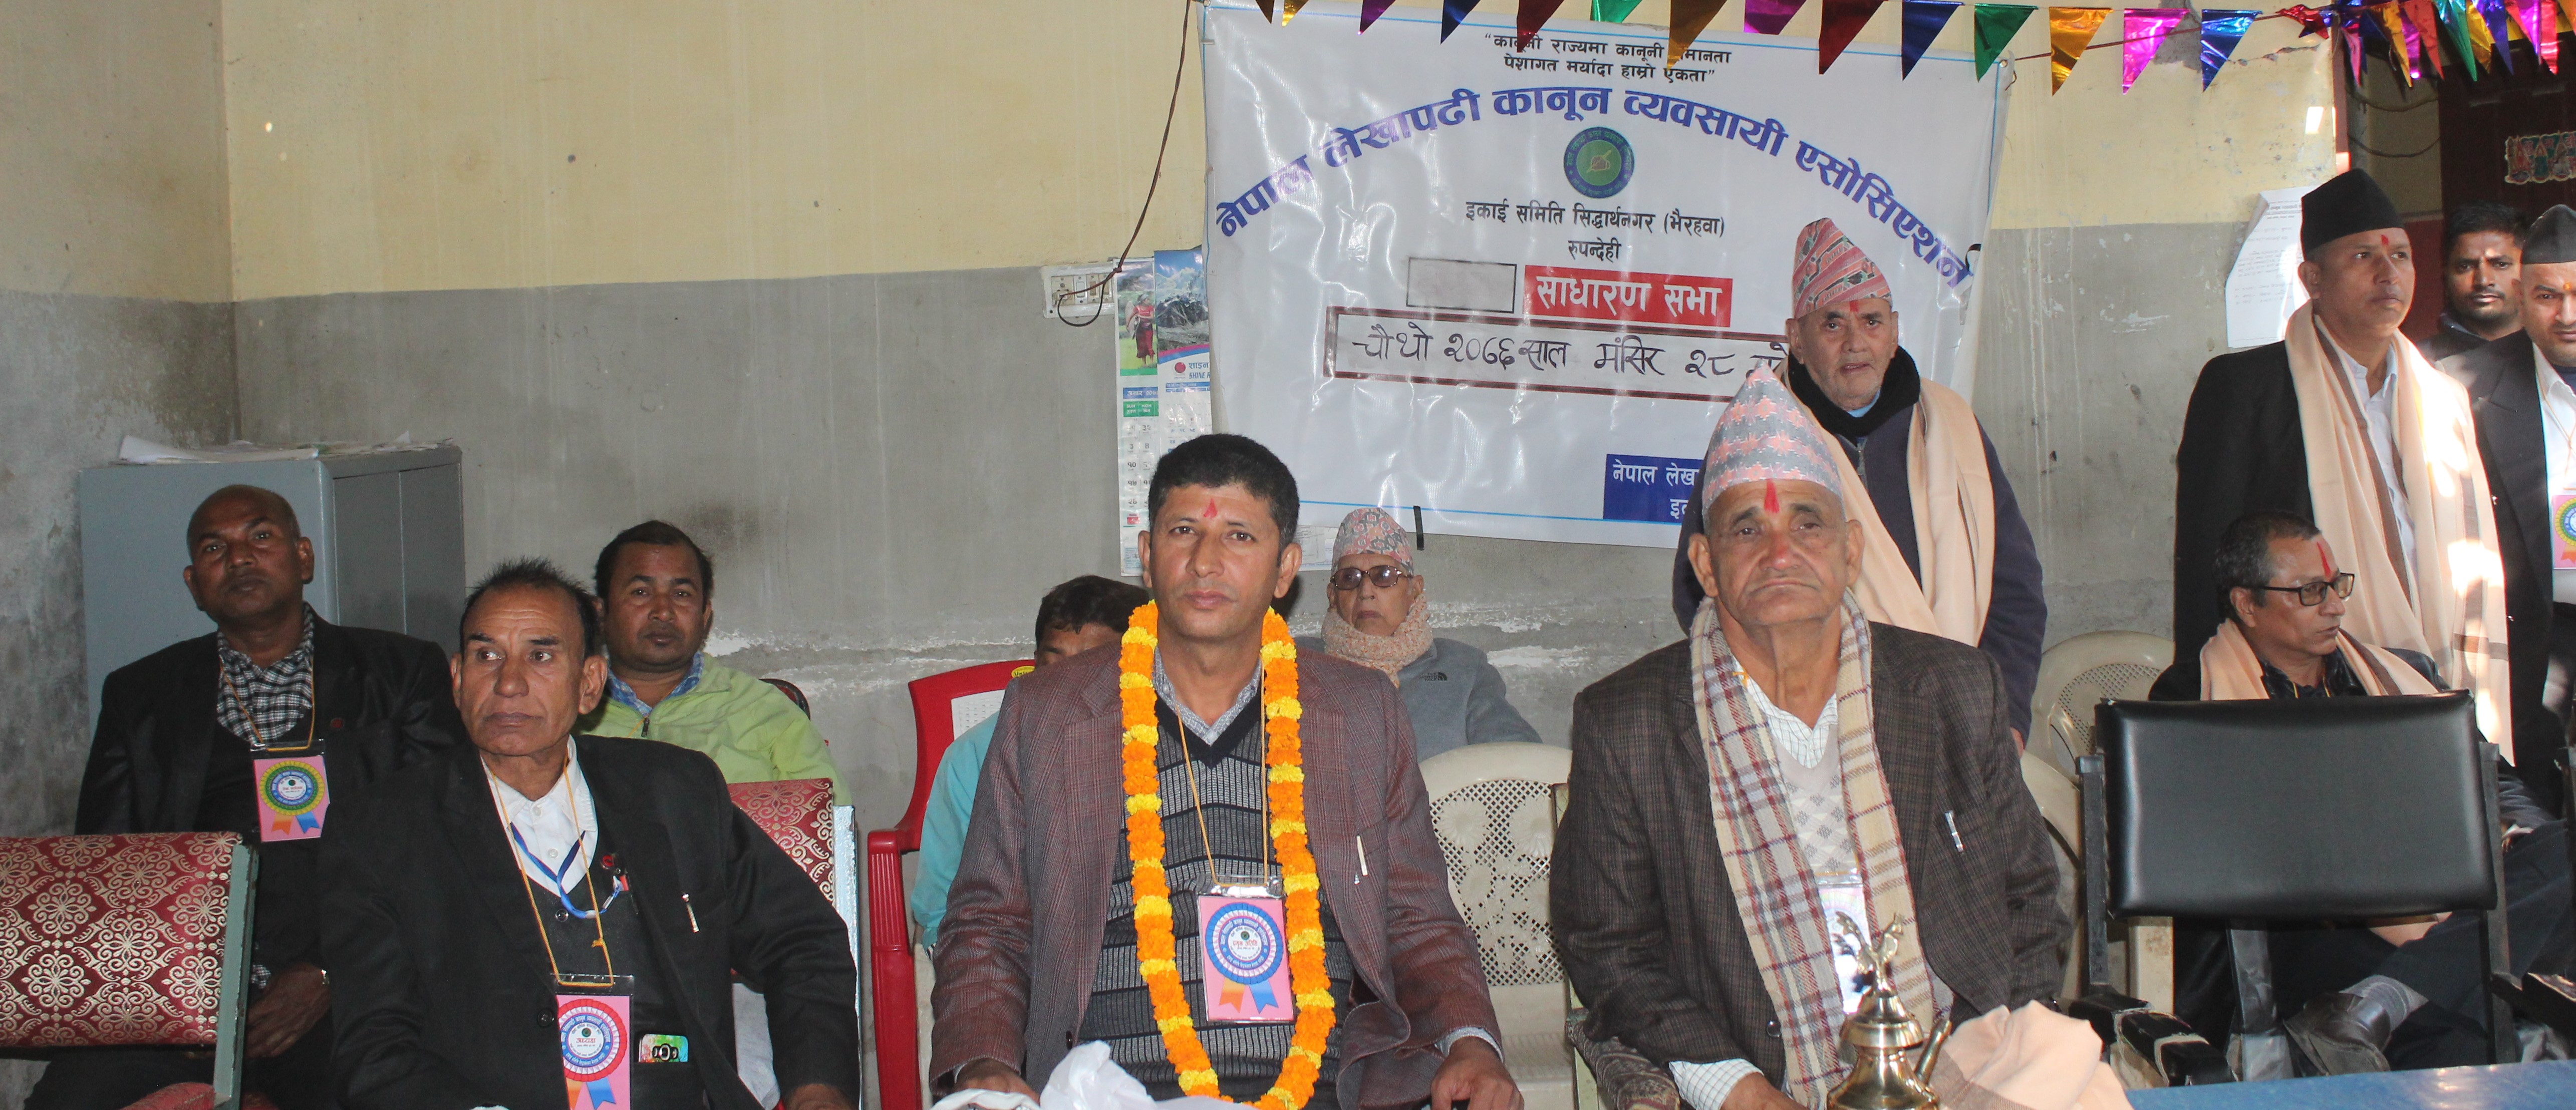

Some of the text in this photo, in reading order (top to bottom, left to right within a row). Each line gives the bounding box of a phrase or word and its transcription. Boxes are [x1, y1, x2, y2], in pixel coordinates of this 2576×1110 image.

[1504, 53, 1559, 71] पेशागत
[1566, 59, 1614, 77] मर्यादा
[1621, 63, 1656, 79] हाम्रो
[1550, 39, 1608, 55] राज्यमा
[1615, 42, 1665, 62] कानूनी
[1680, 49, 1732, 64] मानता
[1216, 86, 1974, 289] नेपाल लेखापढी कानून व्यवसायी एसोसिएशन
[1466, 199, 1725, 237] इकाई समिति सिद्धार्थनगर (भैरहवा)
[1568, 237, 1622, 262] रुपन्देही
[1536, 276, 1723, 318] साधारण सभा
[1594, 335, 1666, 376] मंसिर
[1684, 350, 1736, 379] २८
[1612, 459, 1658, 486] नेपाल
